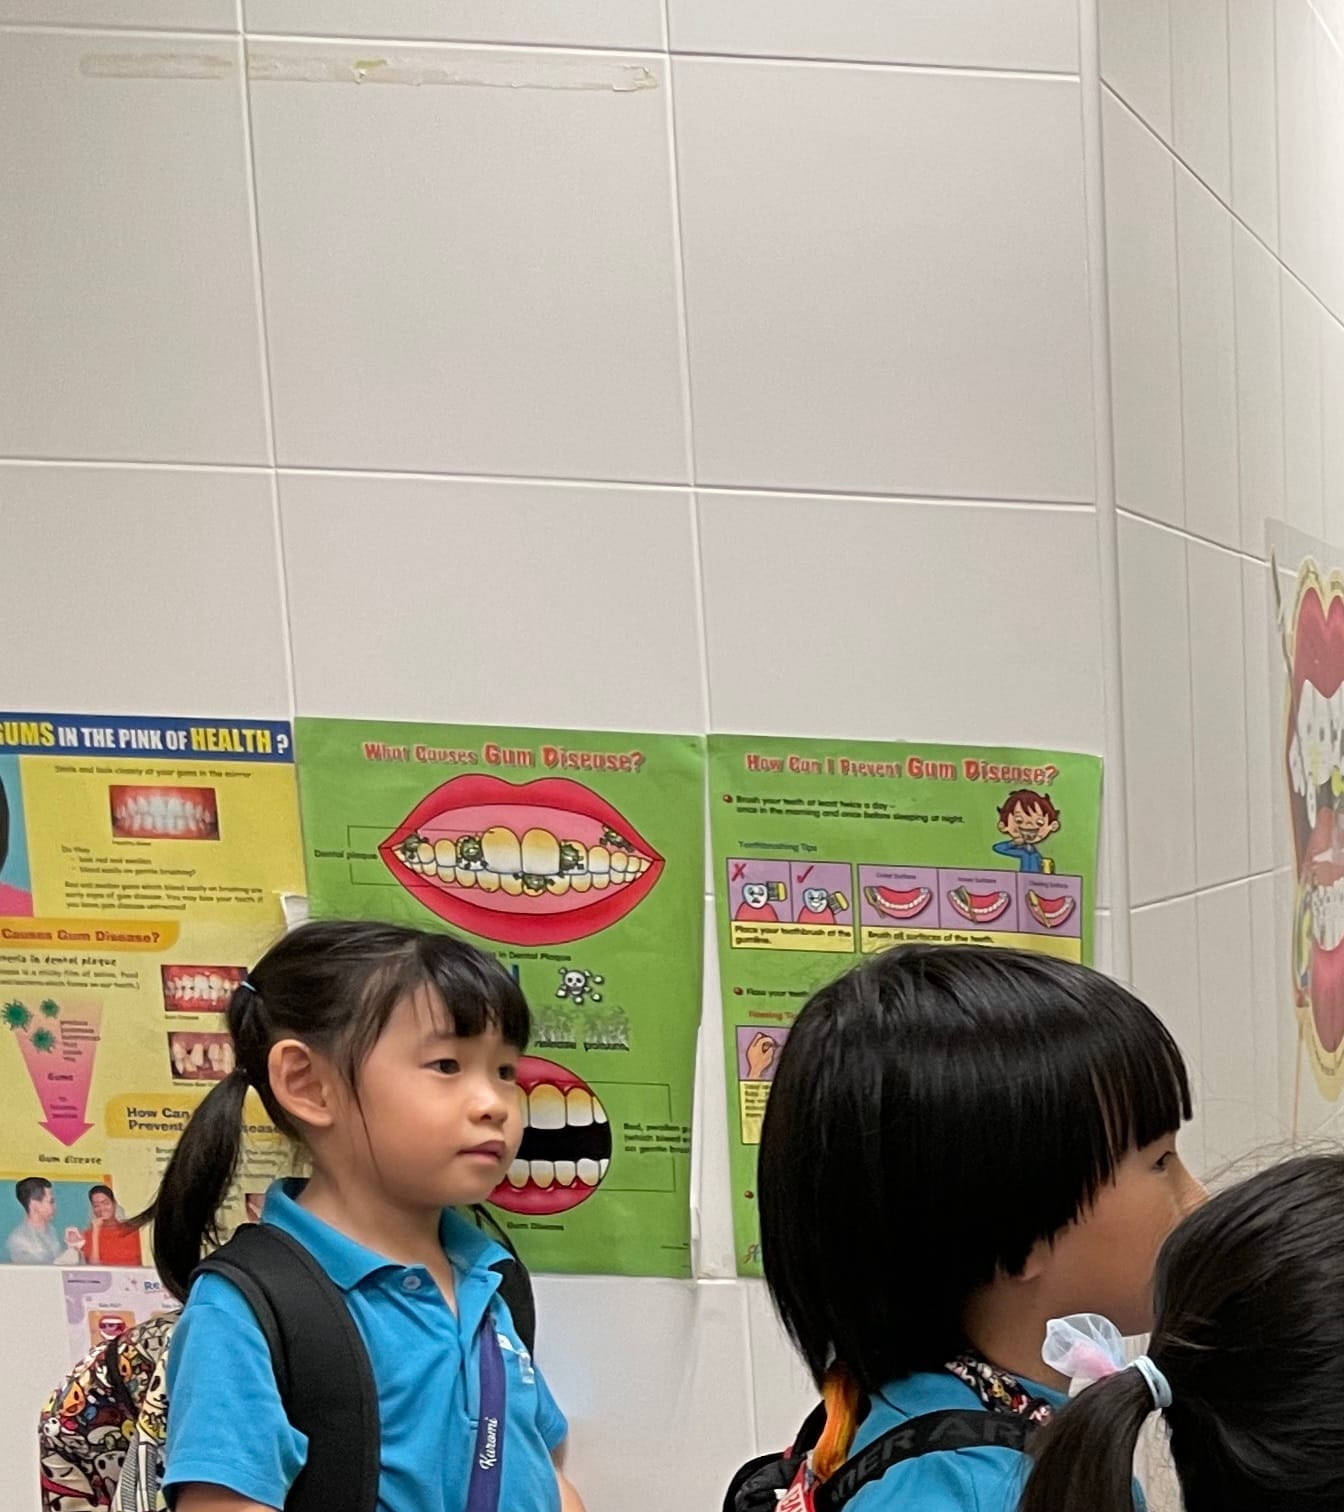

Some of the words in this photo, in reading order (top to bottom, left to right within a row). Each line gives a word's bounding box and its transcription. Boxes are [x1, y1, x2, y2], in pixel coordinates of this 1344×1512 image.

[57, 726, 79, 748] IN
[80, 727, 116, 749] THE
[117, 728, 164, 750] PINK
[165, 729, 188, 751] OF
[190, 727, 273, 754] HEALTH
[363, 742, 408, 762] What
[415, 745, 478, 765] Causes
[482, 743, 534, 768] Gum
[542, 746, 646, 773] Disease?
[746, 753, 782, 774] How
[788, 756, 821, 776] Can
[825, 756, 834, 776] I
[840, 758, 900, 780] Prevent
[907, 755, 957, 782] Gum
[963, 758, 1059, 787] Disease?
[57, 930, 90, 941] Gum
[95, 930, 161, 944] Disease?
[127, 1107, 157, 1118] How
[162, 1107, 190, 1119] Can
[128, 1119, 184, 1132] Prevent
[479, 1416, 498, 1470] Kuromi
